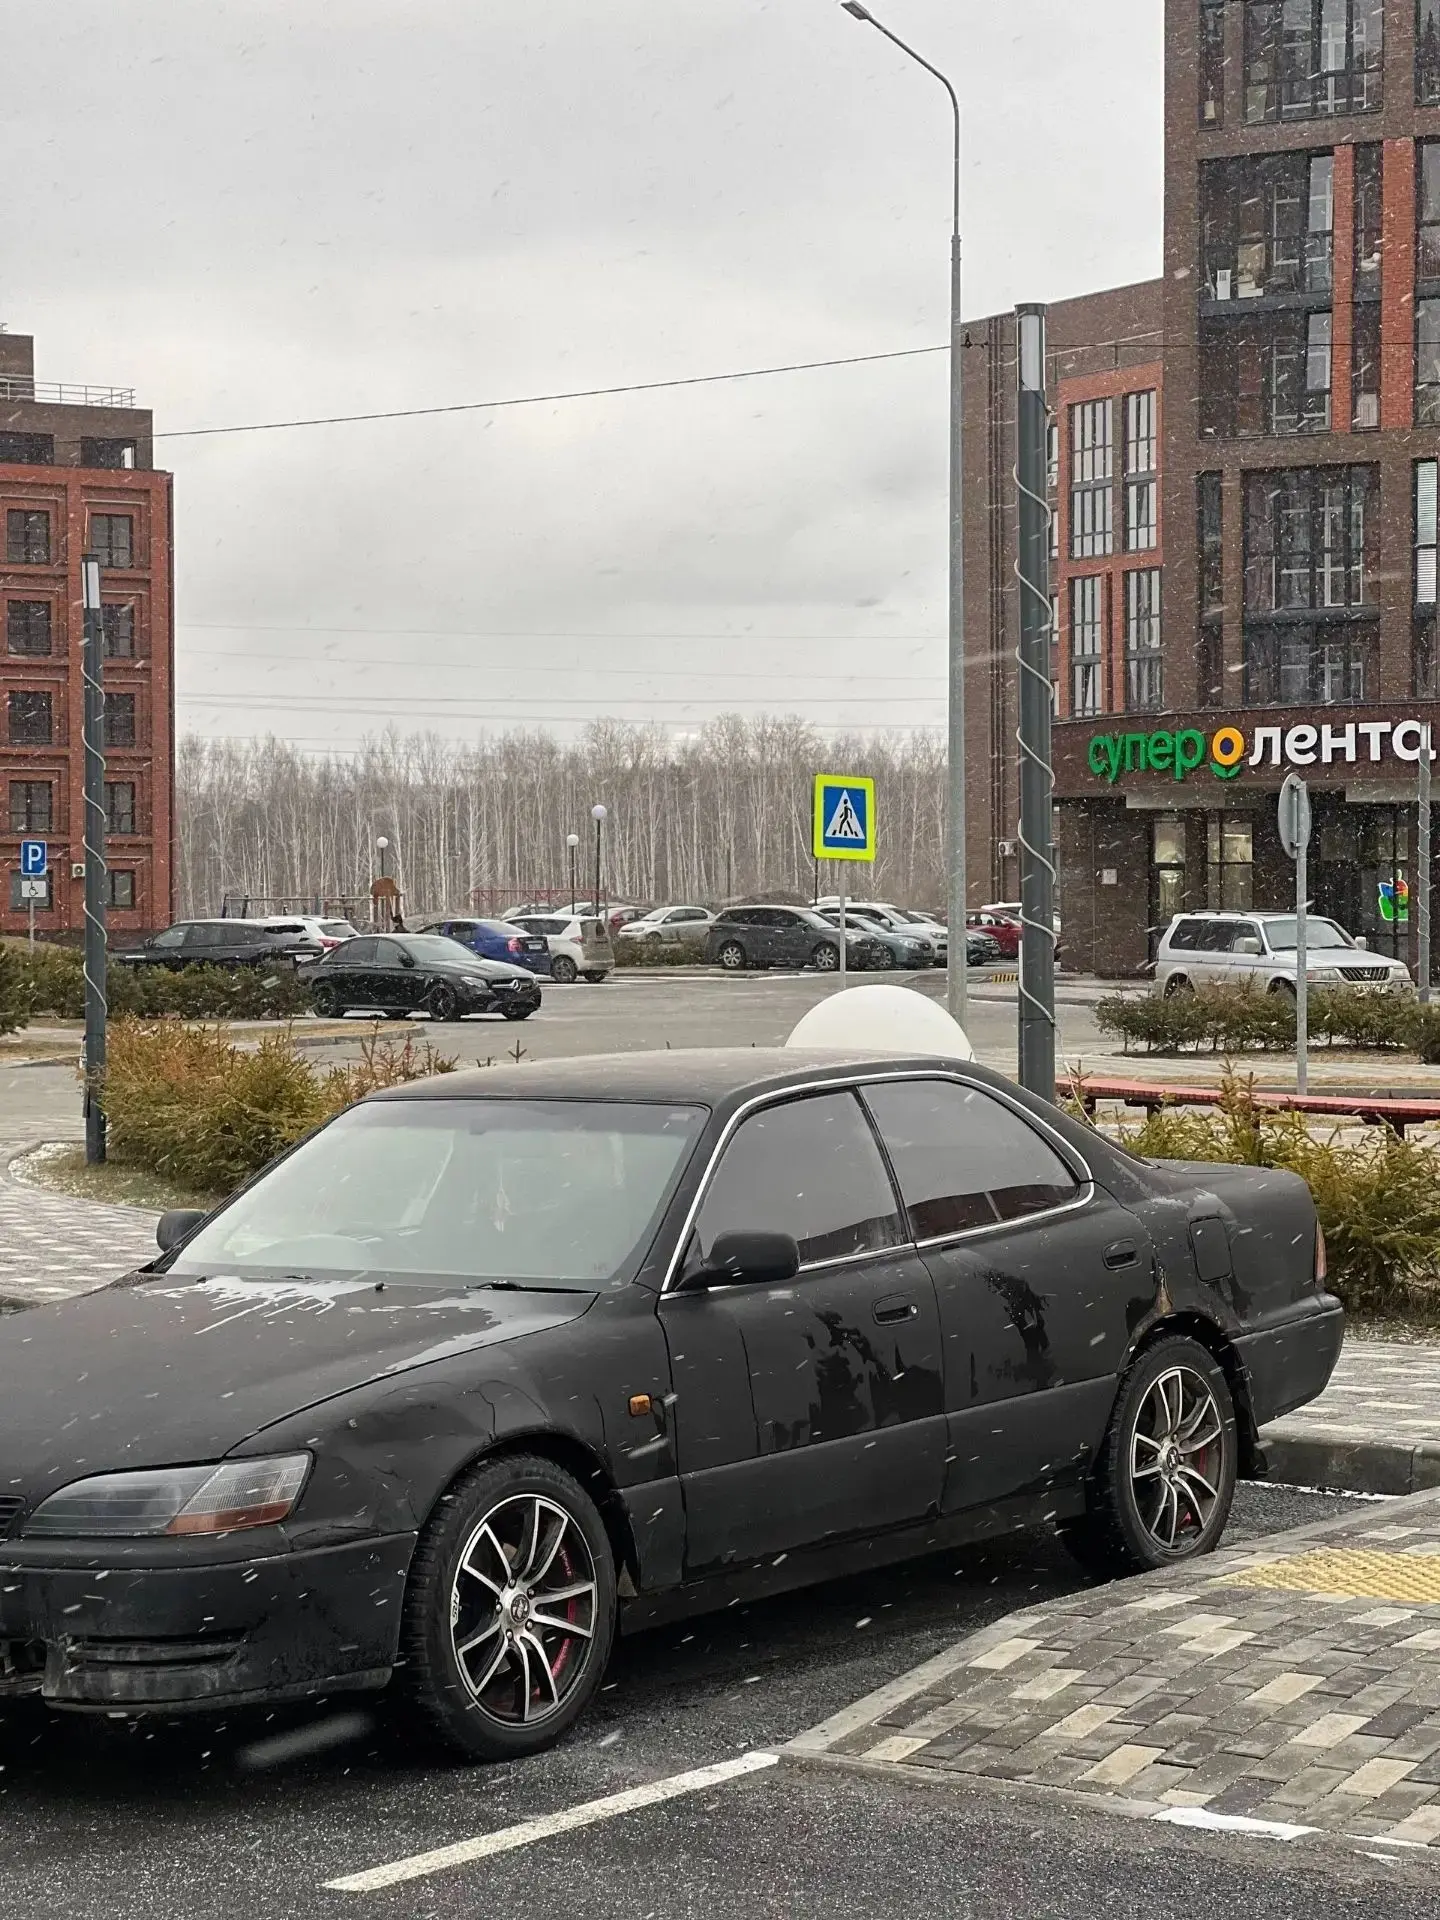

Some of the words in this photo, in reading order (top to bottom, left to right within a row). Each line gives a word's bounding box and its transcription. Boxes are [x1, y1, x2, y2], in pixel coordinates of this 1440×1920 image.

[1088, 728, 1206, 783] супер
[1248, 720, 1437, 766] лента
[28, 844, 42, 871] P
